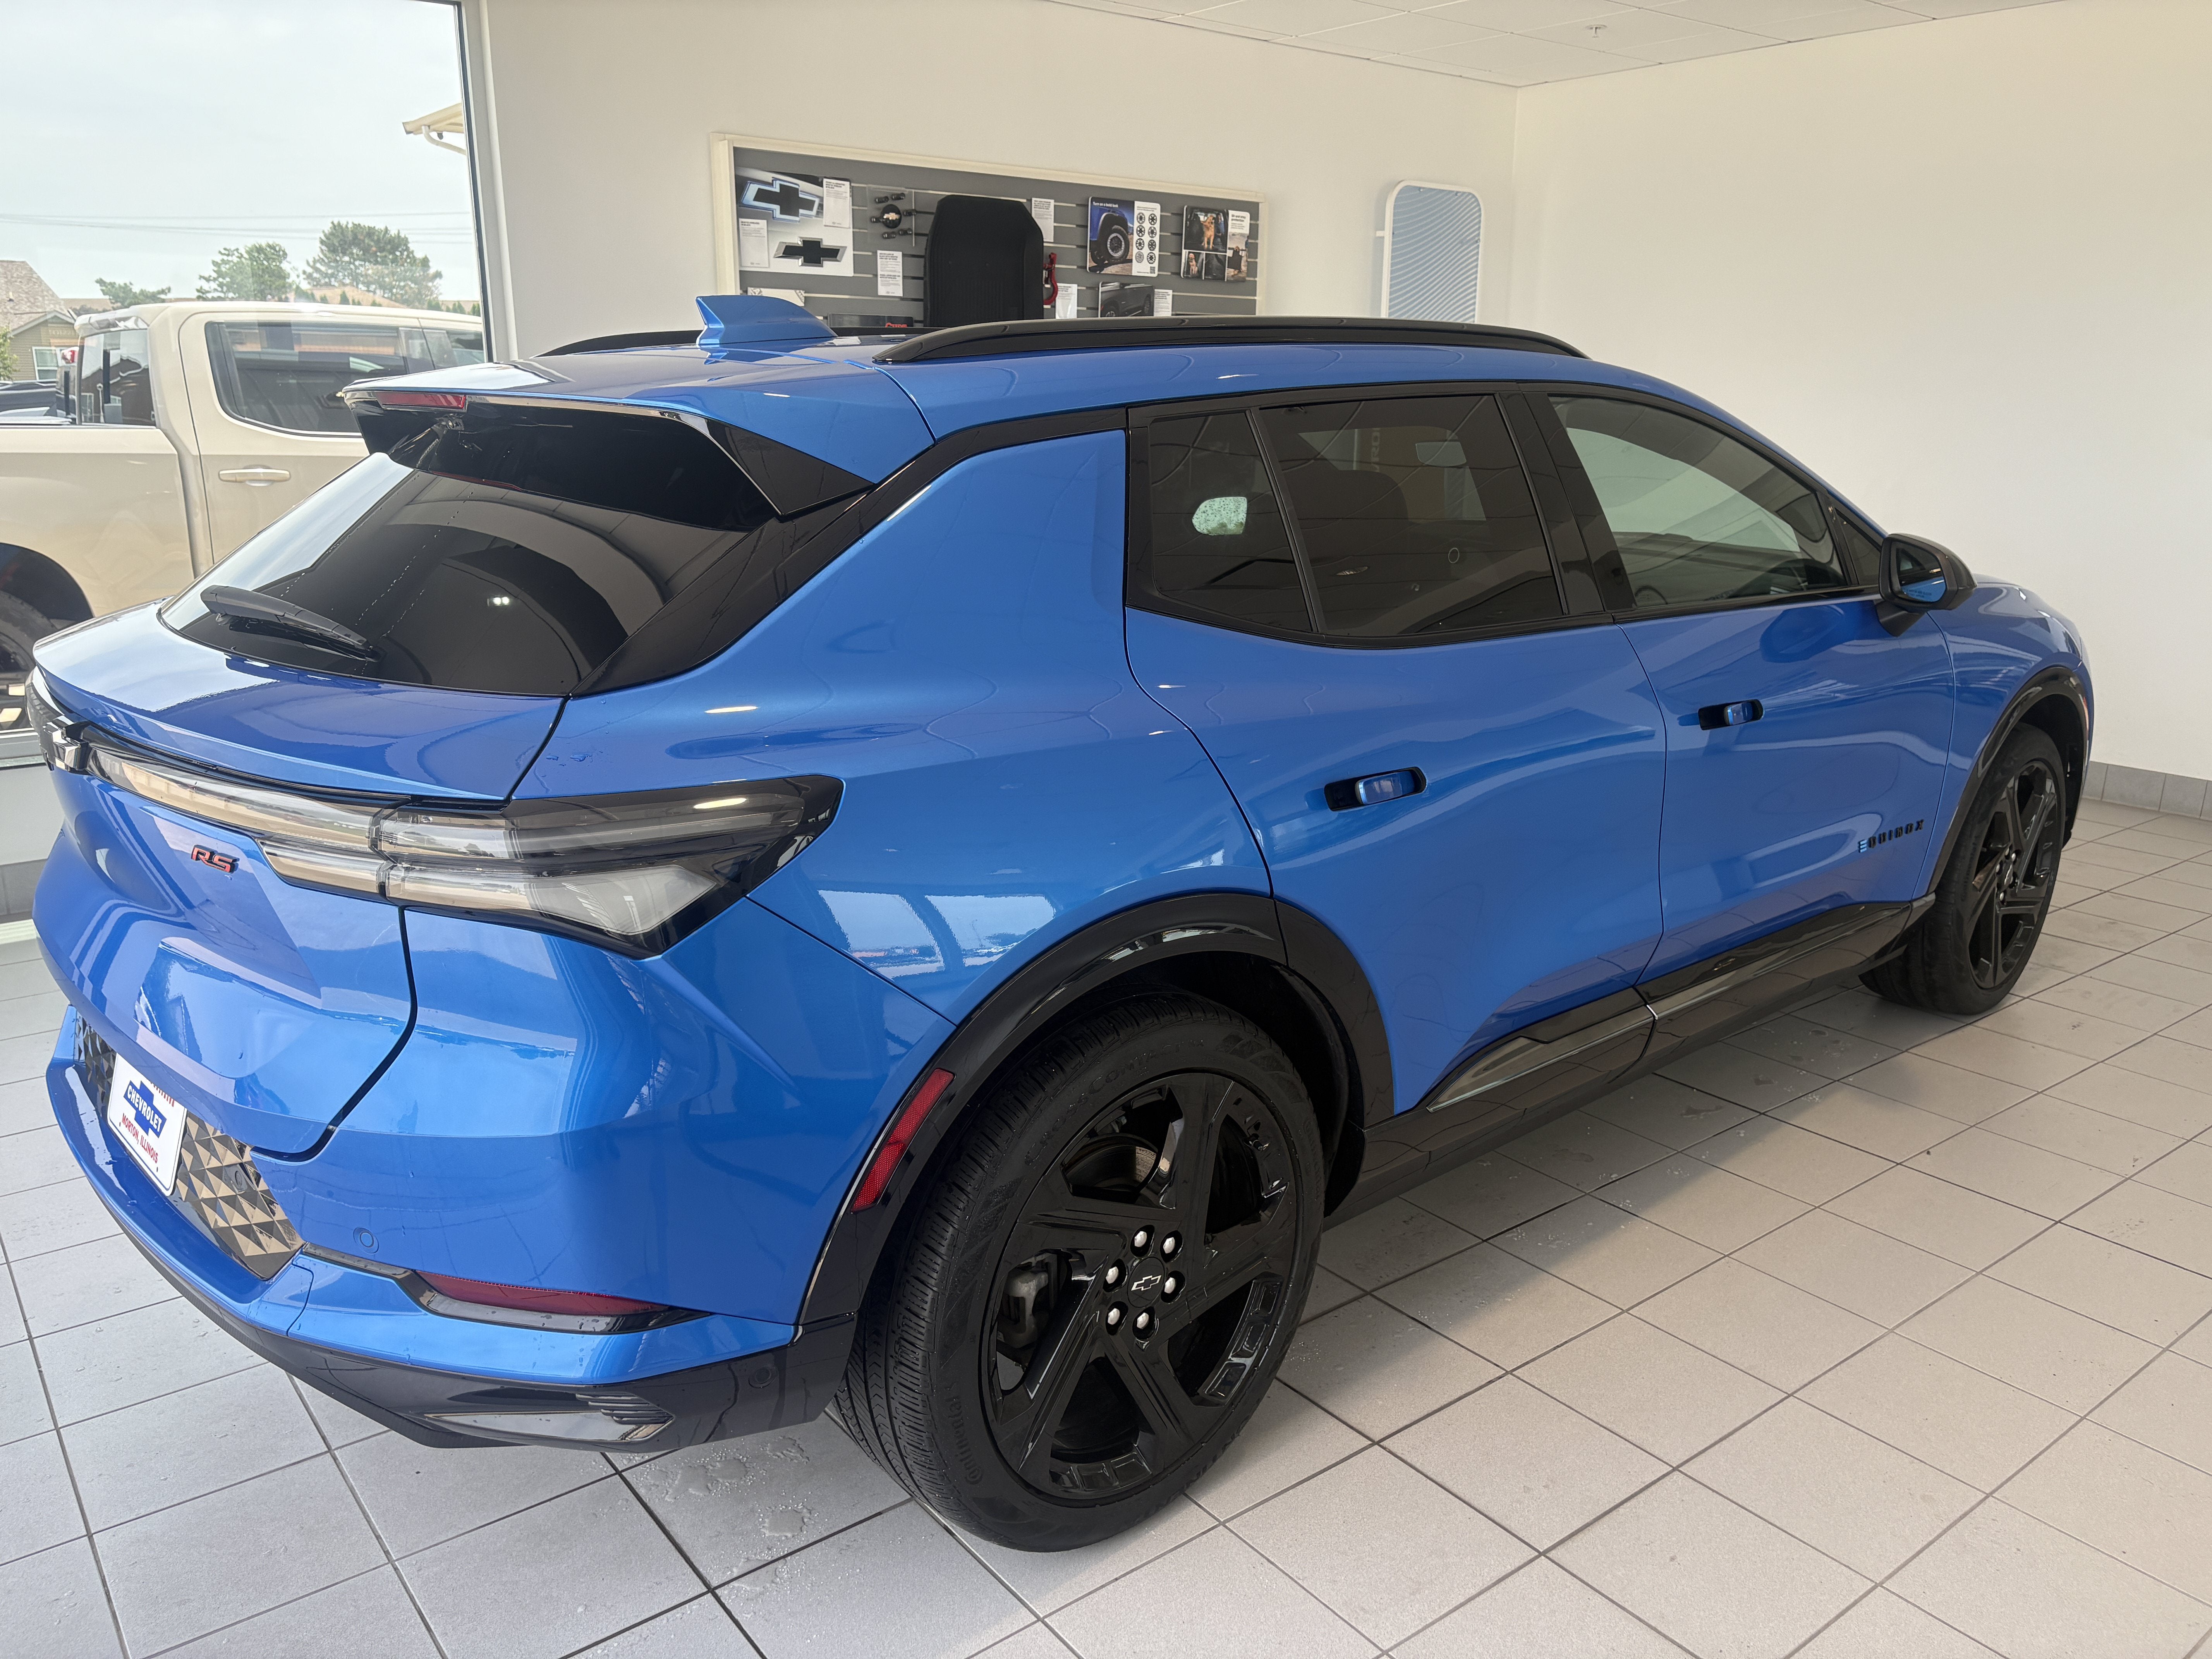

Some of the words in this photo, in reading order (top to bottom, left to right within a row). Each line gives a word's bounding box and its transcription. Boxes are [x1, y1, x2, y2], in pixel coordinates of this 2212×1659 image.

[1859, 819, 1924, 853] EQUINOX
[191, 845, 240, 874] RS
[127, 1084, 162, 1133] CHEVROLET
[122, 1112, 139, 1145] MORTON,
[140, 1135, 158, 1164] ILLINOIS
